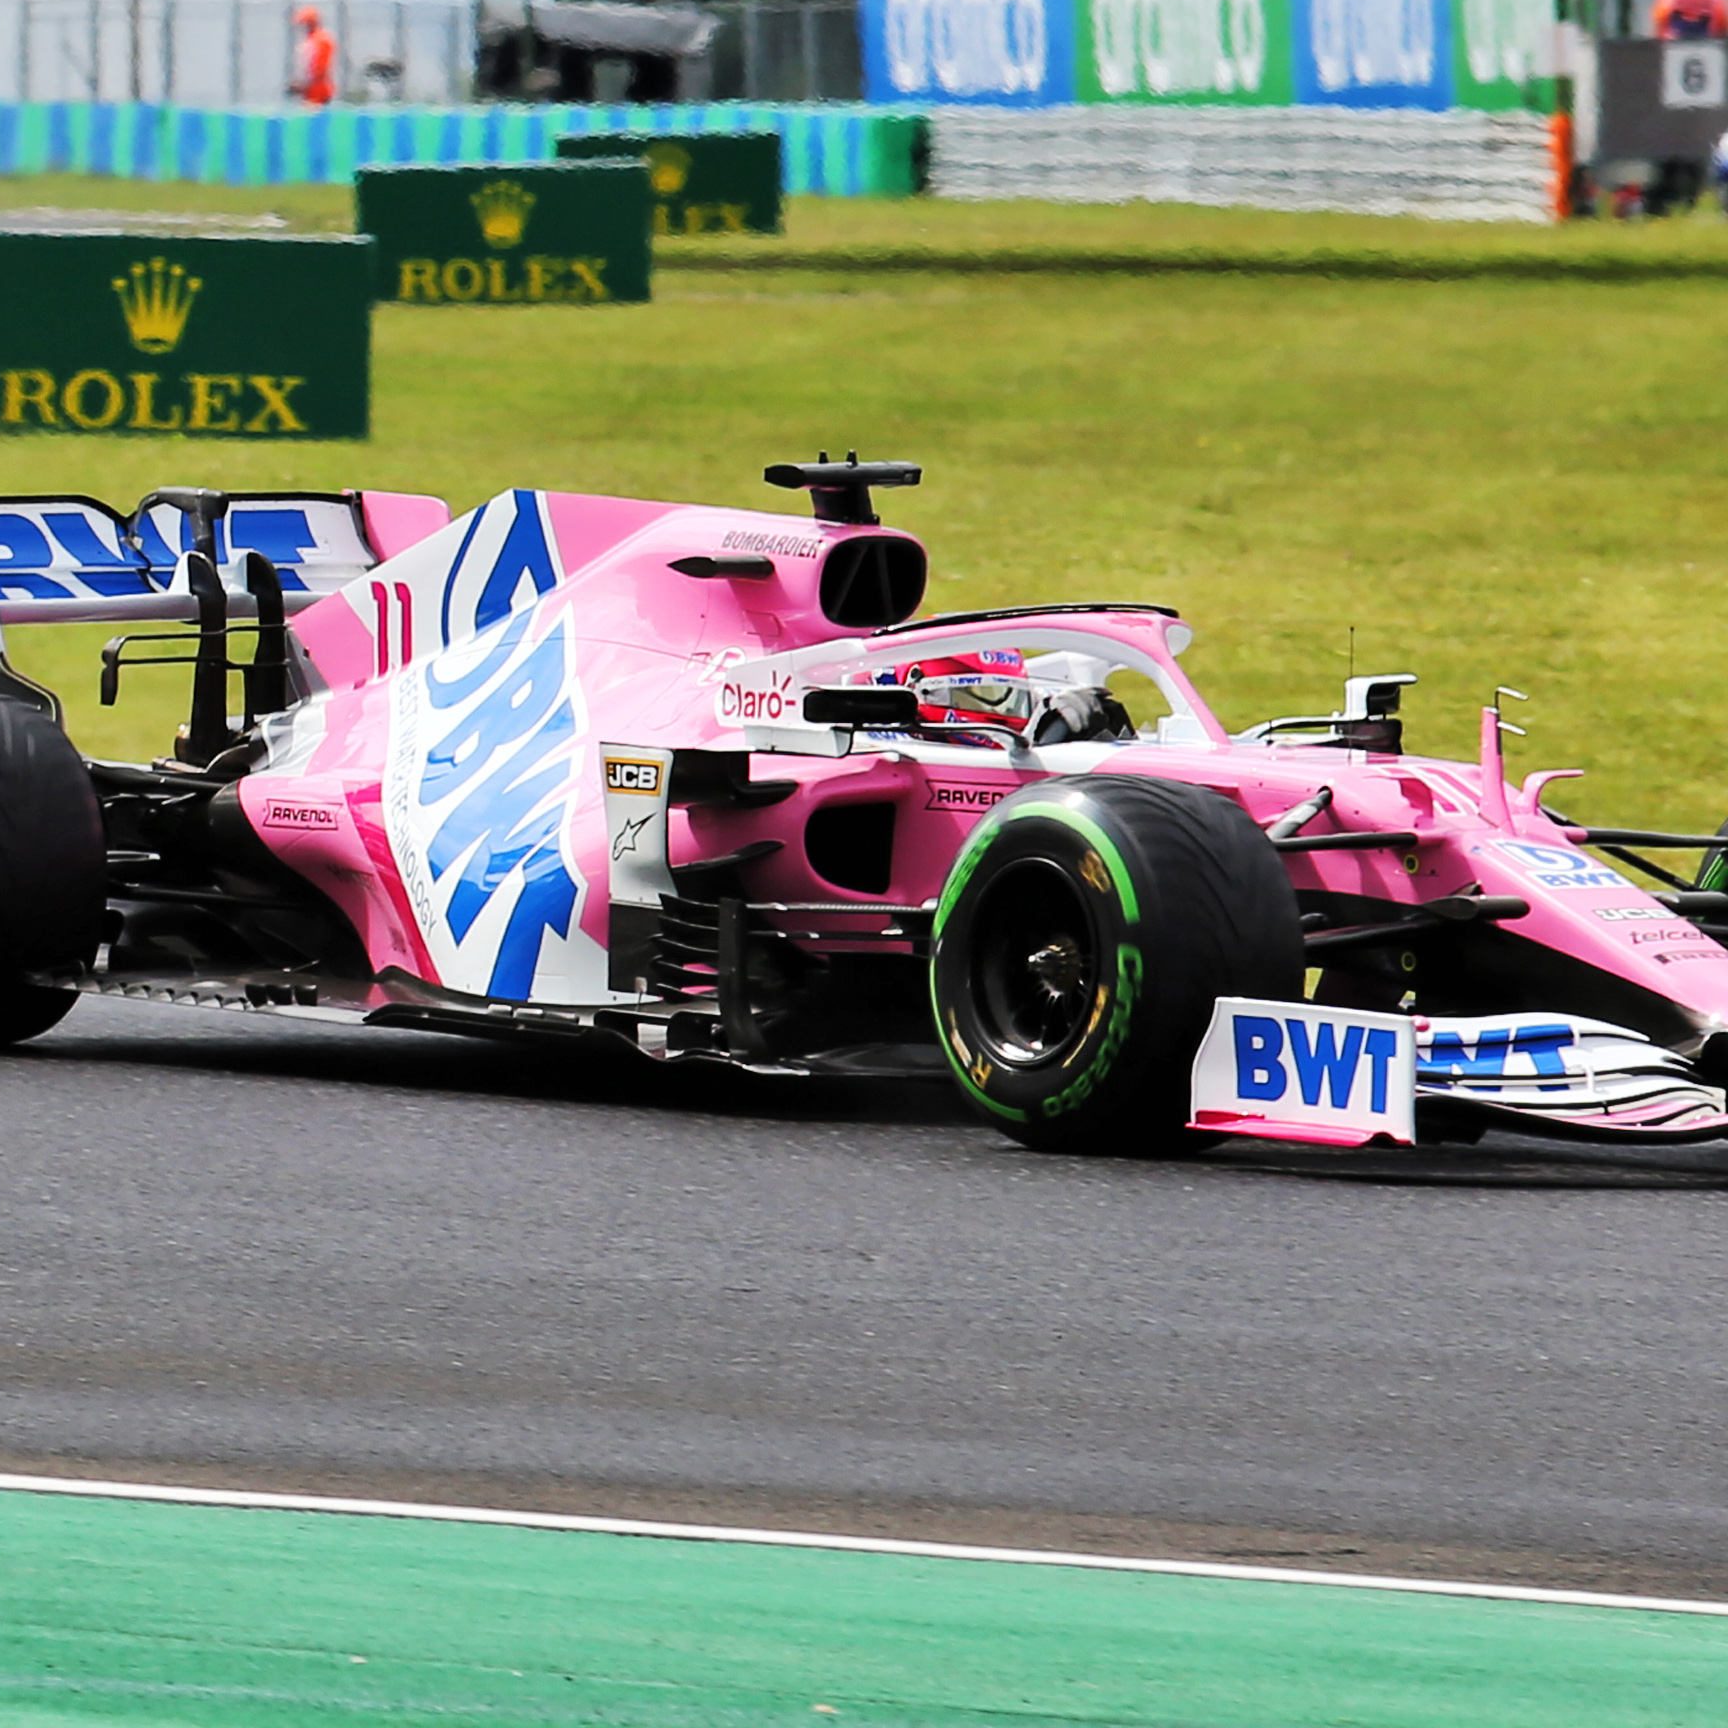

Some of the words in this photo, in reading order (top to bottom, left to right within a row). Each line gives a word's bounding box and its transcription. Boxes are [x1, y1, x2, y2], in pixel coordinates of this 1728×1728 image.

[652, 203, 750, 235] LEX
[397, 255, 611, 302] ROLEX
[720, 530, 821, 559] BOMBARDIER
[370, 581, 413, 678] 11
[721, 679, 787, 720] Claro
[607, 765, 658, 790] JCB
[272, 807, 334, 823] RAVENOL
[937, 789, 1004, 806] RAVEN
[391, 781, 439, 938] TECHNOLOGY
[1537, 872, 1628, 887] BWT
[1232, 1014, 1397, 1114] BWT
[1416, 1023, 1574, 1092] WT
